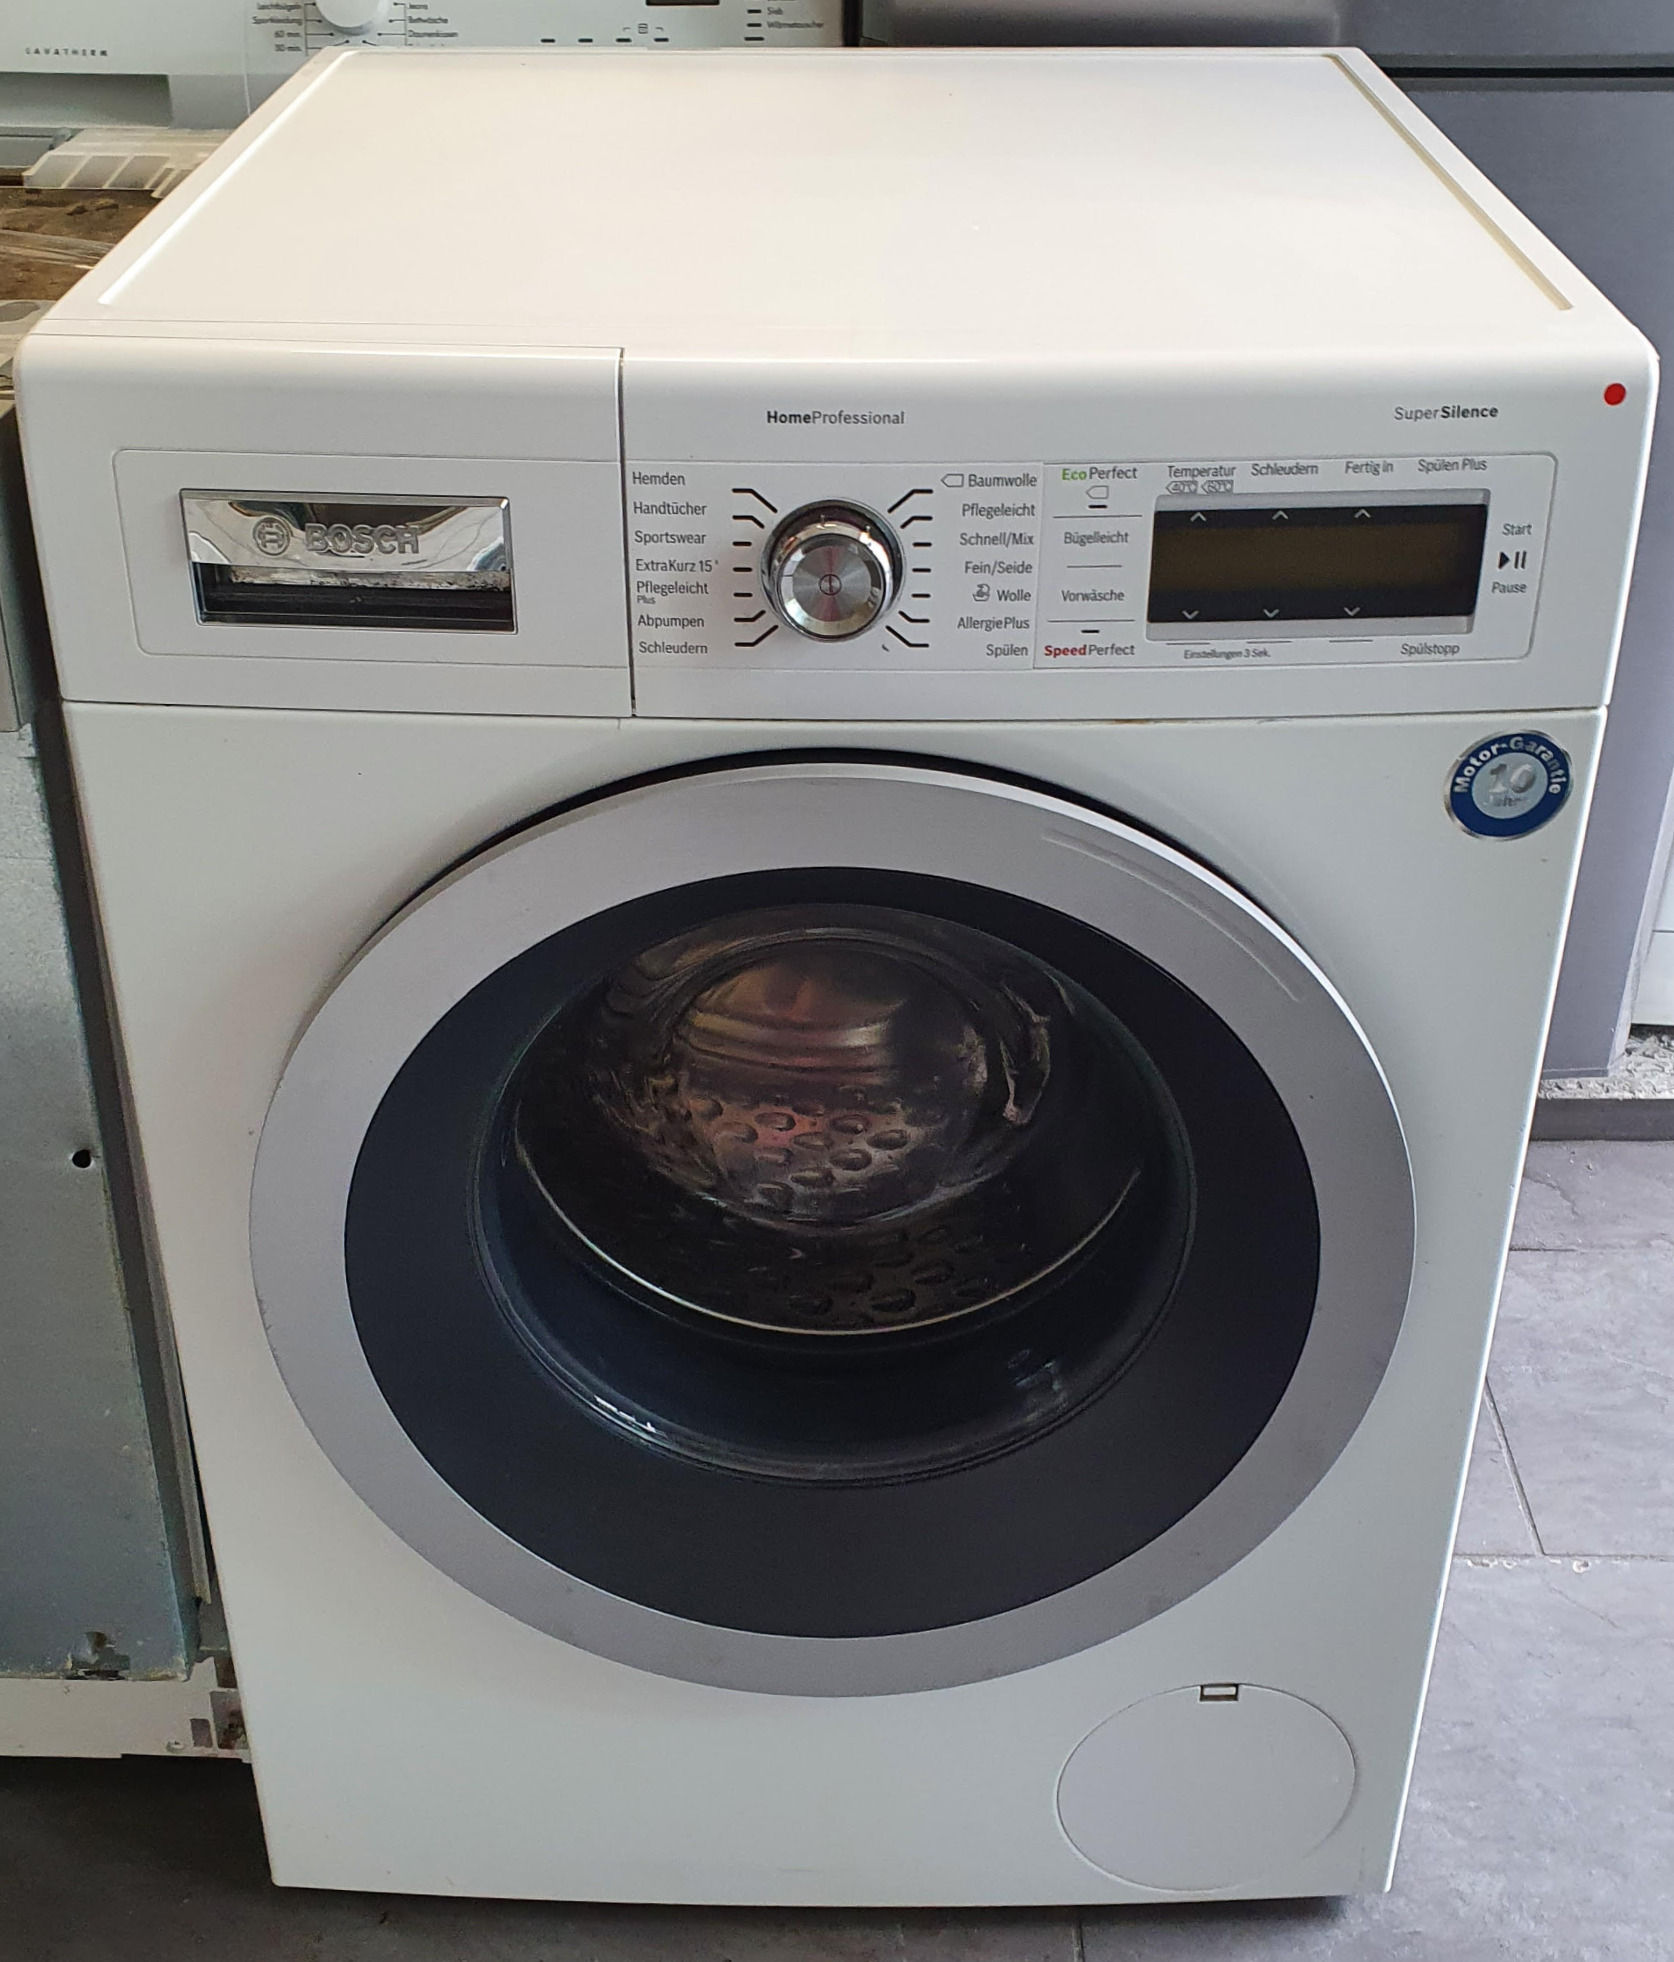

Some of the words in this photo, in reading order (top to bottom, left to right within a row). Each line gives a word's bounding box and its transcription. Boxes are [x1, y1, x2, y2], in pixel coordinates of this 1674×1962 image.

[766, 410, 905, 424] HomeProfessional
[1168, 465, 1237, 480] Temperatur
[1251, 463, 1319, 476] Schleudern
[1345, 460, 1381, 476] Fertig
[1382, 460, 1394, 473] in
[1418, 459, 1460, 474] Spülen
[1461, 458, 1488, 471] Plus
[632, 472, 686, 485] Hemden
[968, 473, 1038, 487] Baumwolle
[633, 501, 708, 515] Handtücher
[962, 503, 1036, 520] Pflegeleicht
[1502, 523, 1532, 536] Start
[305, 523, 420, 554] BOSCH
[634, 530, 707, 546] Sportswear
[960, 532, 1035, 548] Schnell/Mix
[1064, 531, 1129, 547] Bügelleicht
[636, 559, 697, 572] ExtraKurz
[965, 561, 1033, 576] Fein/Seide
[637, 580, 709, 597] Pflegeleicht
[1492, 581, 1527, 594] Pause
[637, 595, 657, 605] Plus
[997, 589, 1032, 602] Wolle
[1061, 589, 1125, 602] Vorwäsche
[638, 614, 705, 629] Abpumpen
[957, 616, 1030, 632] AllergiePlus
[639, 640, 708, 654] Schleudern
[986, 643, 1029, 659] Spülen
[1244, 648, 1250, 658] 3
[1400, 642, 1460, 656] Spülstopp
[1453, 736, 1567, 794] Motor-Garantie
